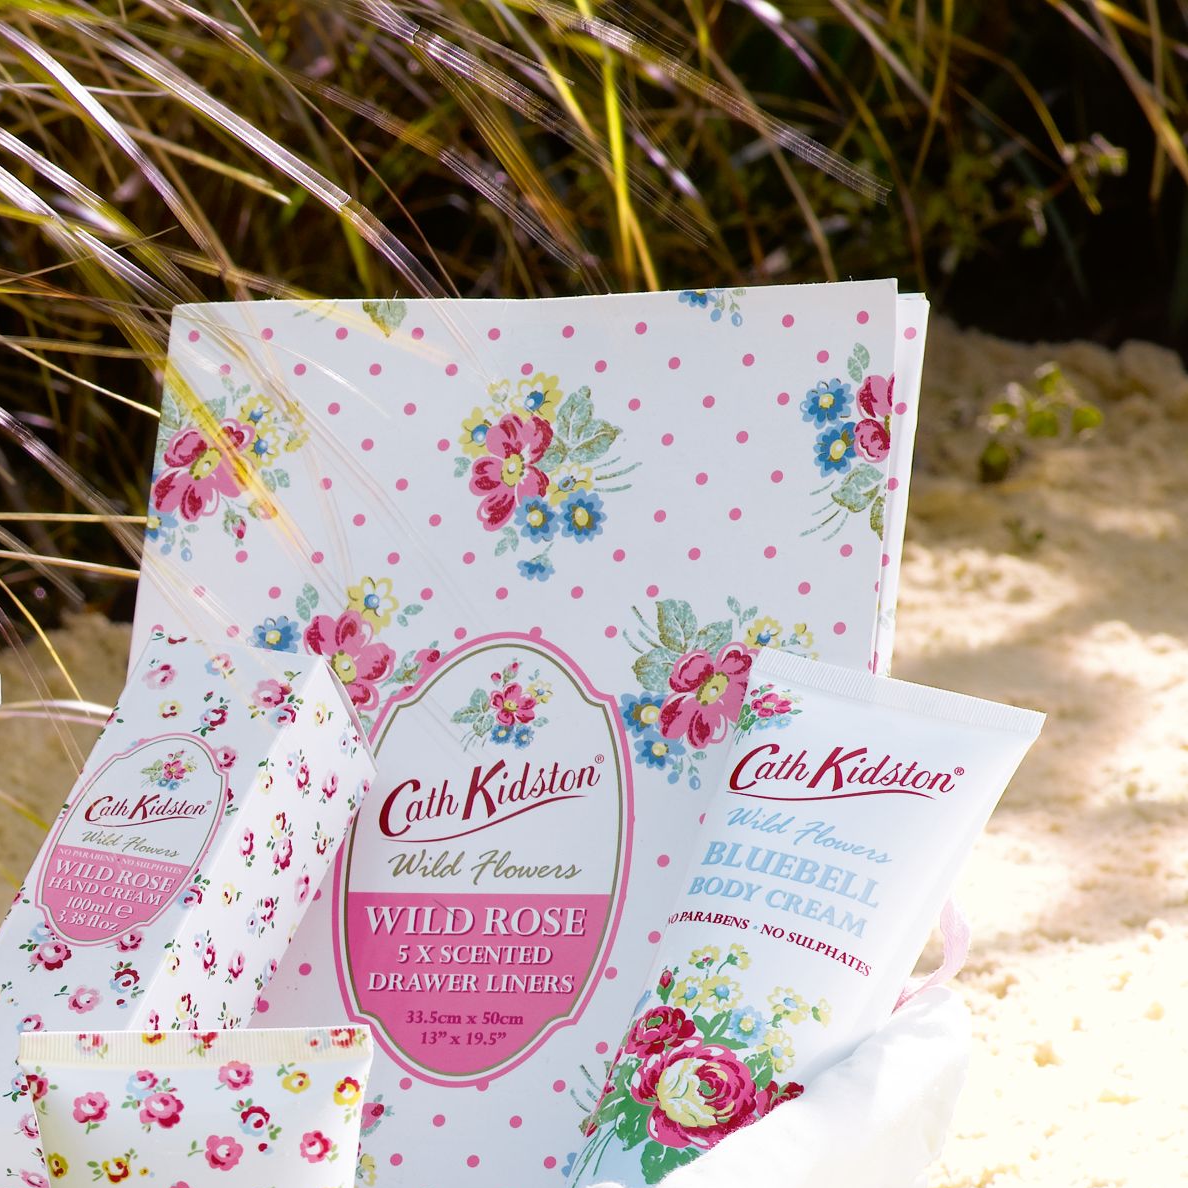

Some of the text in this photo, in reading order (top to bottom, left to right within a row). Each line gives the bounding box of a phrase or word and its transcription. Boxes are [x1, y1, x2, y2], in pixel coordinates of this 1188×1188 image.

[729, 743, 955, 793] Cath Kidston
[84, 793, 207, 822] Cath Kidston
[379, 759, 601, 837] Cath Kidston
[82, 831, 179, 858] Wild Flowers
[727, 806, 892, 864] Wild Flowers
[56, 858, 176, 893] WILD ROSE
[388, 849, 582, 885] Wild Flowers
[701, 841, 879, 908] BLUEBELL
[48, 877, 162, 906] HAND CREAM
[66, 896, 114, 914] 100ml
[365, 906, 587, 937] WILD ROSE
[687, 877, 868, 939] BODY CREAM
[397, 945, 553, 965] 5 X SCENTED
[679, 911, 750, 929] PARABENS
[759, 924, 784, 939] NO
[787, 932, 872, 977] SULPHATES
[367, 973, 575, 994] DRAWER LINERS
[405, 1011, 524, 1025] 33.5cm x 50cm
[450, 1035, 460, 1045] x
